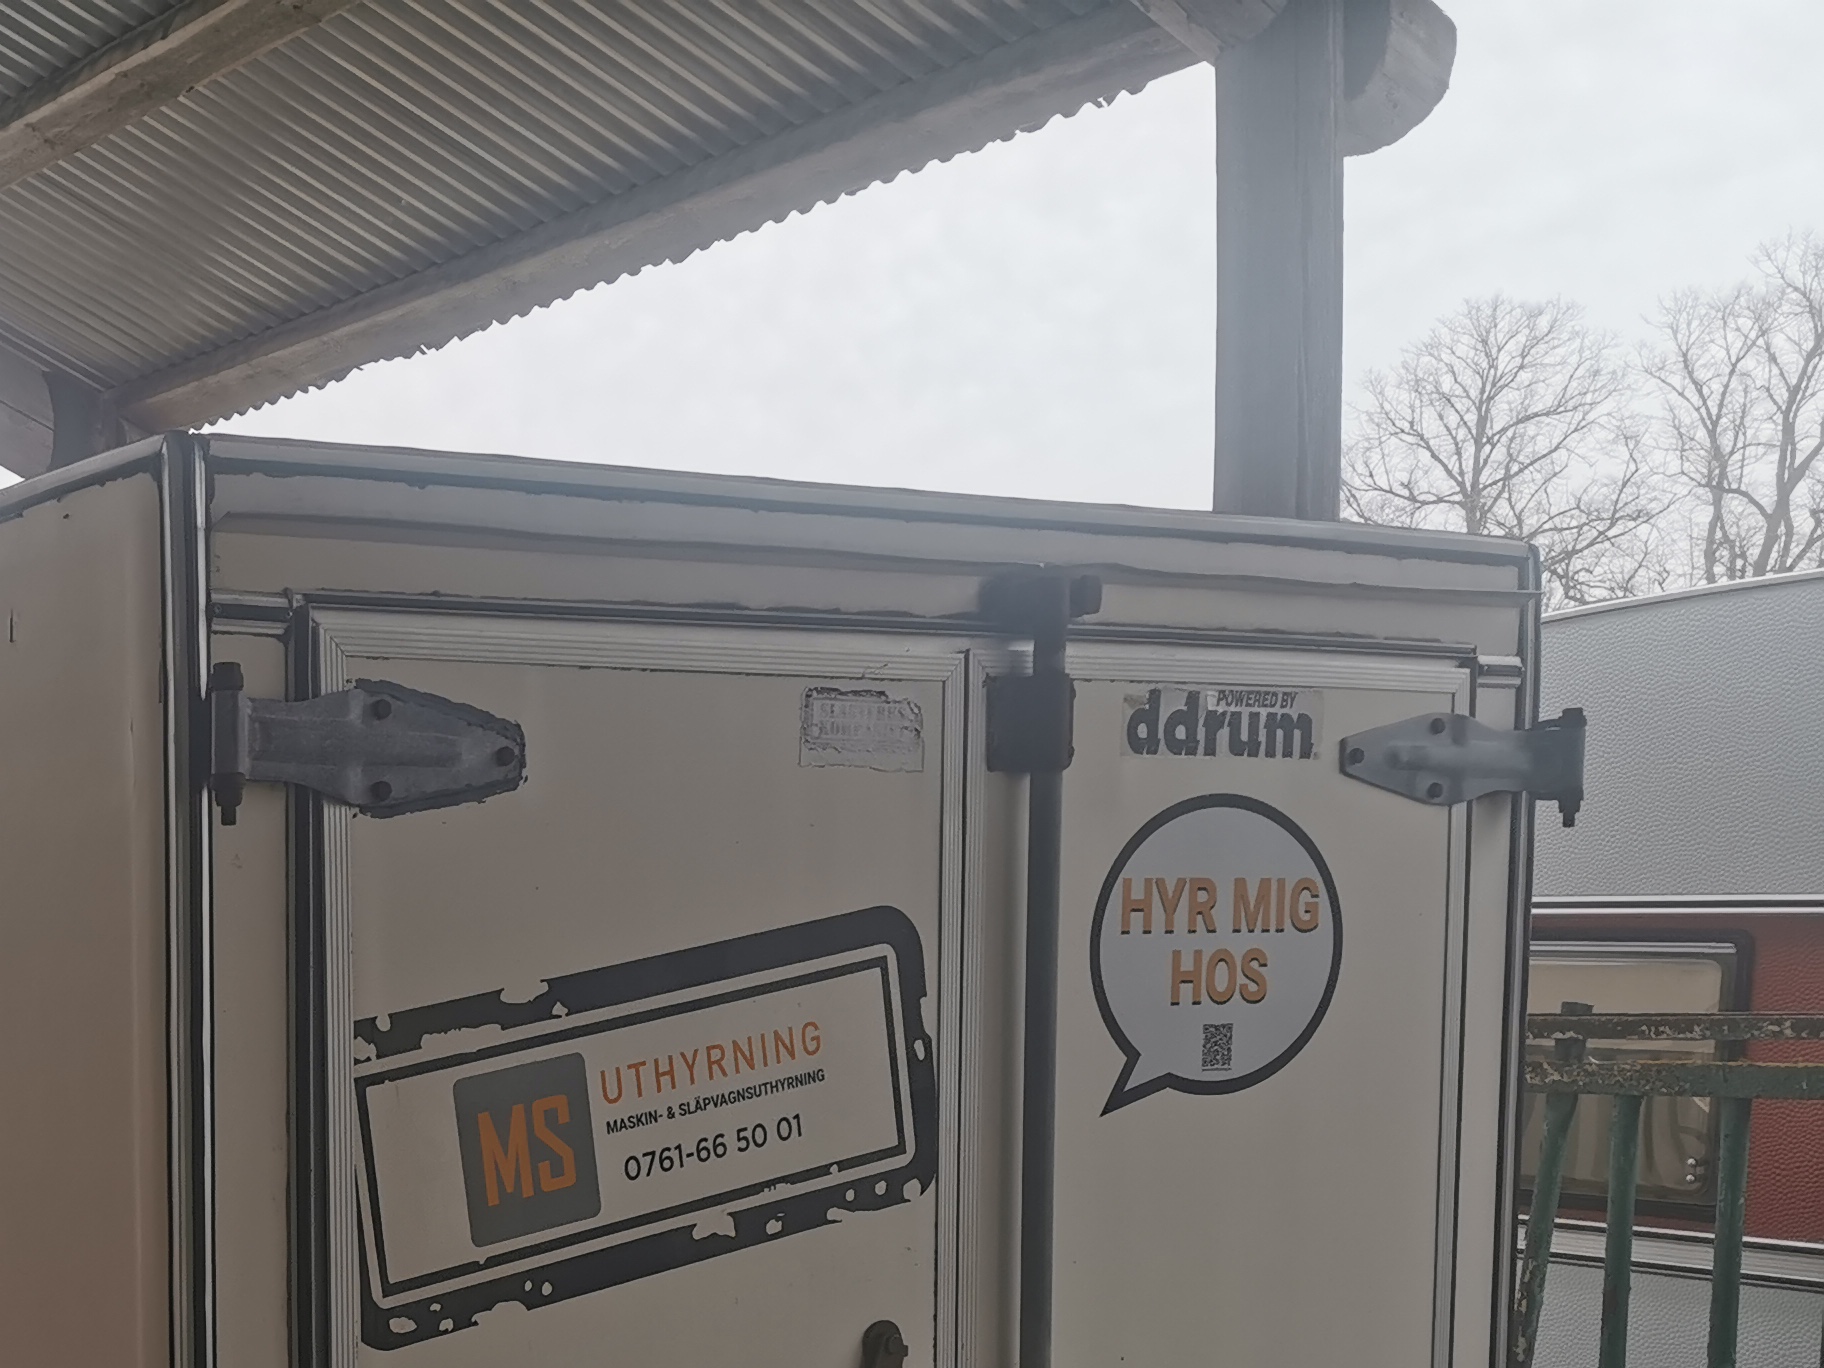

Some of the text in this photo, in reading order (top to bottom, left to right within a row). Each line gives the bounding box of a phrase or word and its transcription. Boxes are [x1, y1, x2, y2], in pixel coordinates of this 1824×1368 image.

[1127, 687, 1314, 760] ddrum
[1216, 690, 1299, 709] POWERED BY
[1120, 876, 1320, 935] HYR MIG
[1169, 947, 1269, 1007] HOS
[600, 1021, 822, 1105] UTHYRNING
[605, 1068, 826, 1135] MASKIN- & SLÄPVAGNSUTHYRNING
[477, 1094, 578, 1207] MS
[624, 1113, 803, 1181] 0761-66 50 01
